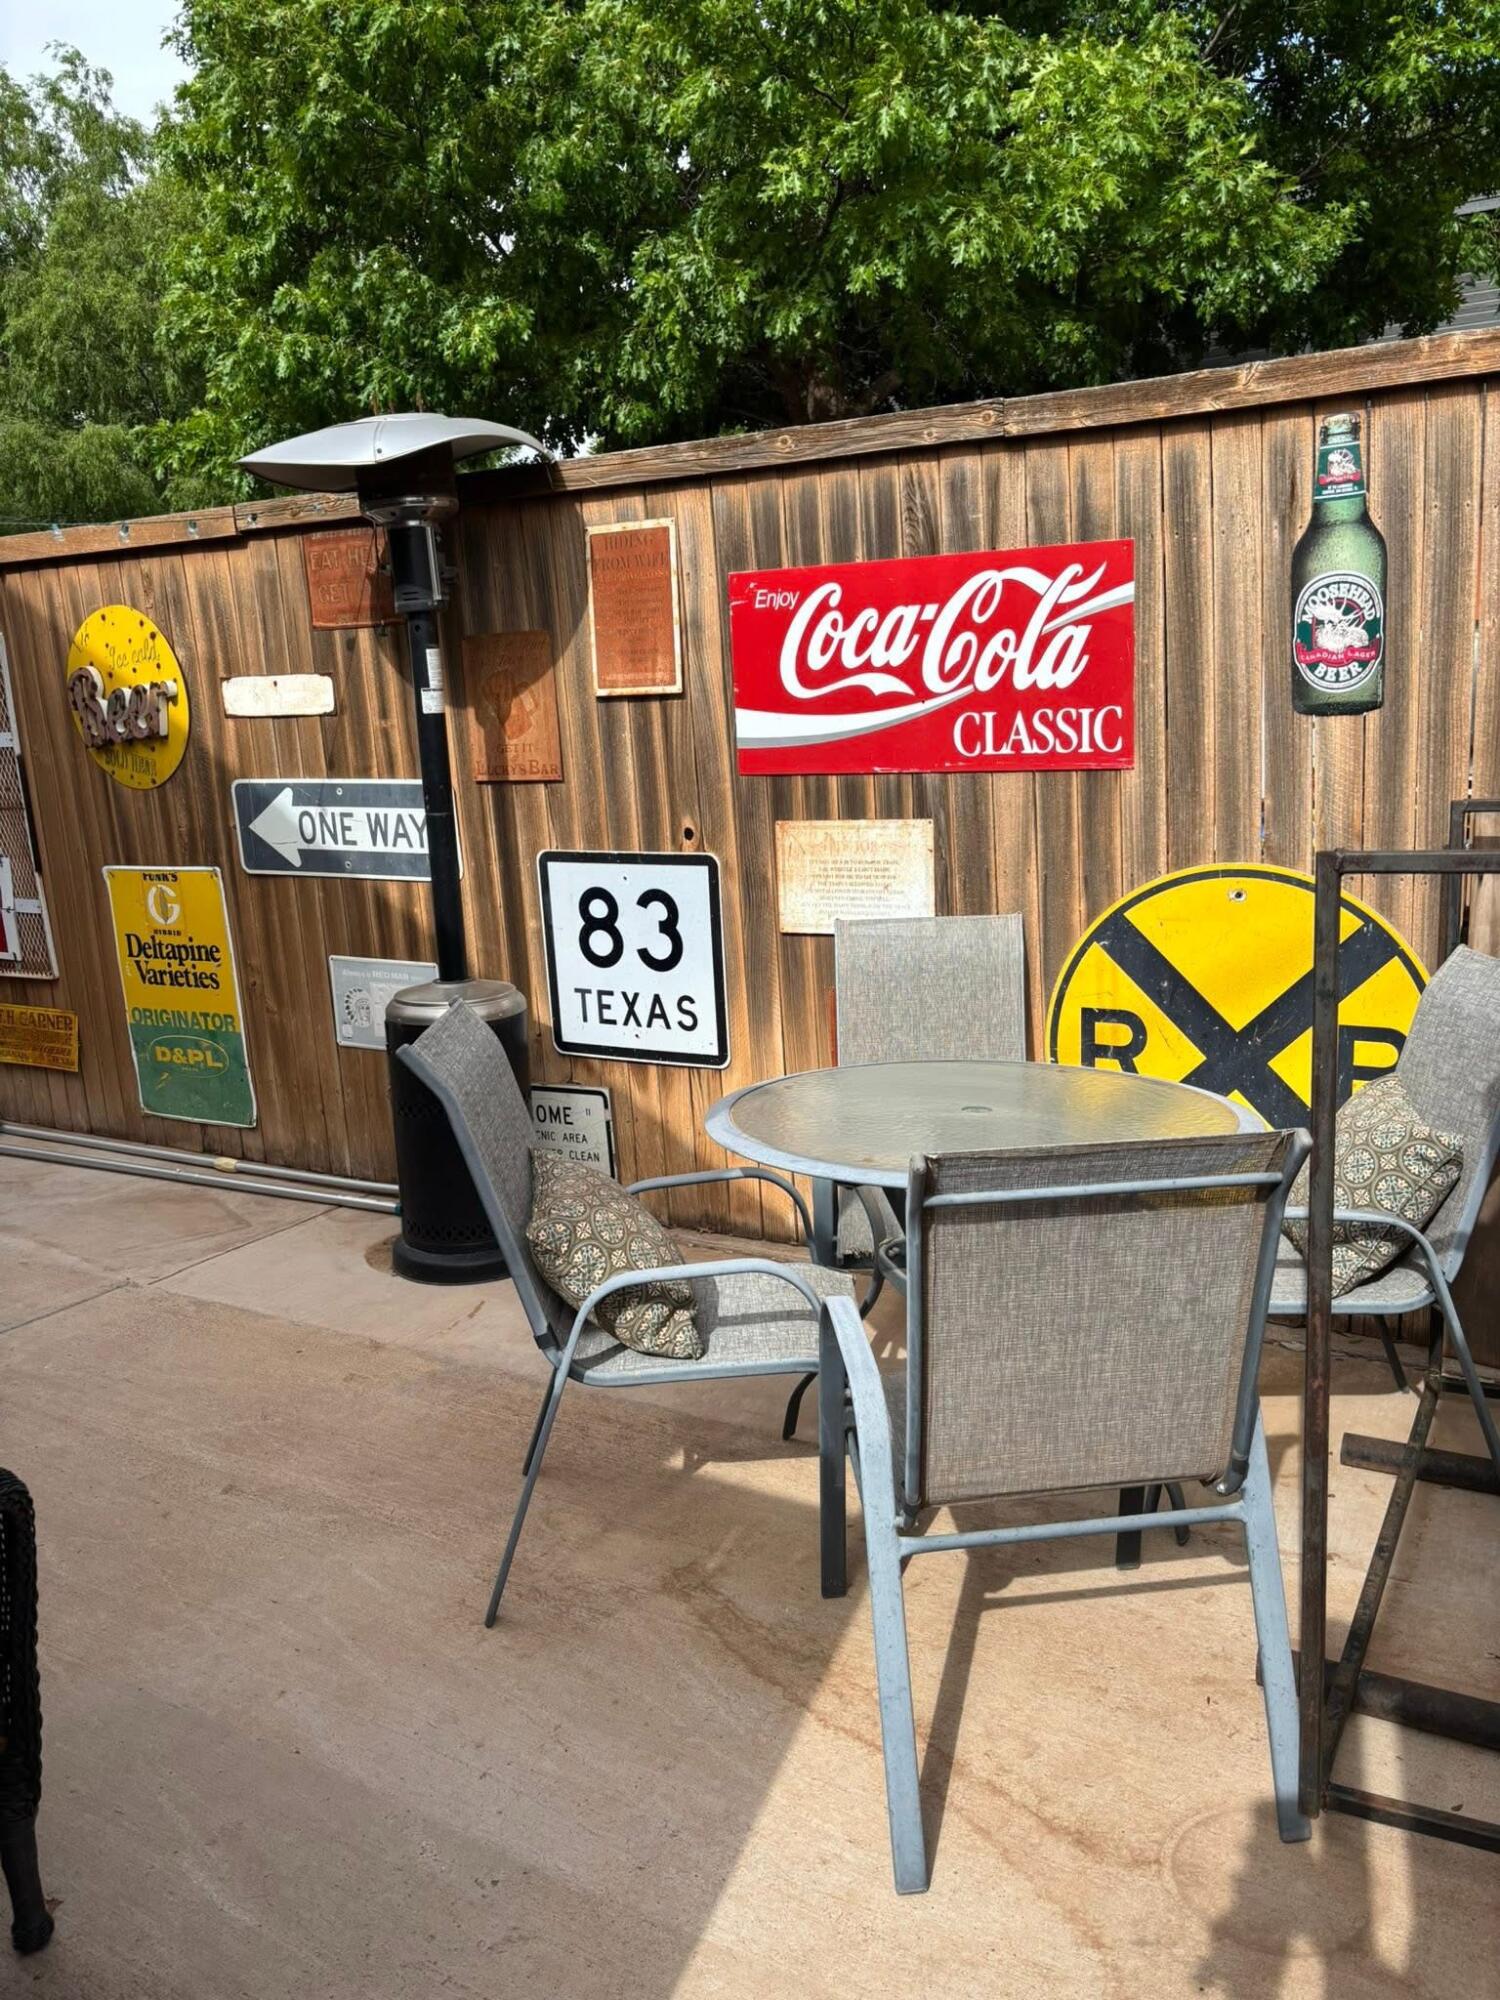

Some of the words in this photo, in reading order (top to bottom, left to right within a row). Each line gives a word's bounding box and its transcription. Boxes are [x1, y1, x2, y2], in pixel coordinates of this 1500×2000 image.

[310, 549, 340, 570] EAT
[318, 582, 349, 603] GET
[754, 588, 799, 610] Enjoy
[1301, 582, 1376, 624] MOOSEHEAD
[779, 561, 1107, 699] Coca-Cola
[1347, 649, 1376, 659] LAGER
[1314, 661, 1363, 682] BEER
[67, 665, 178, 749] Beer
[952, 705, 1123, 757] CLASSIC
[298, 810, 358, 846] ONE
[366, 812, 427, 849] WAY
[578, 886, 684, 973] 83
[124, 933, 222, 967] Deltapine
[134, 959, 221, 990] Varieties
[130, 1006, 236, 1032] ORIGINATOR
[574, 987, 698, 1032] TEXAS
[1080, 1006, 1148, 1077] R
[154, 1045, 223, 1069] D&PL
[536, 1104, 574, 1126] OME
[562, 1132, 588, 1145] AREA
[568, 1149, 600, 1163] CLEAN
